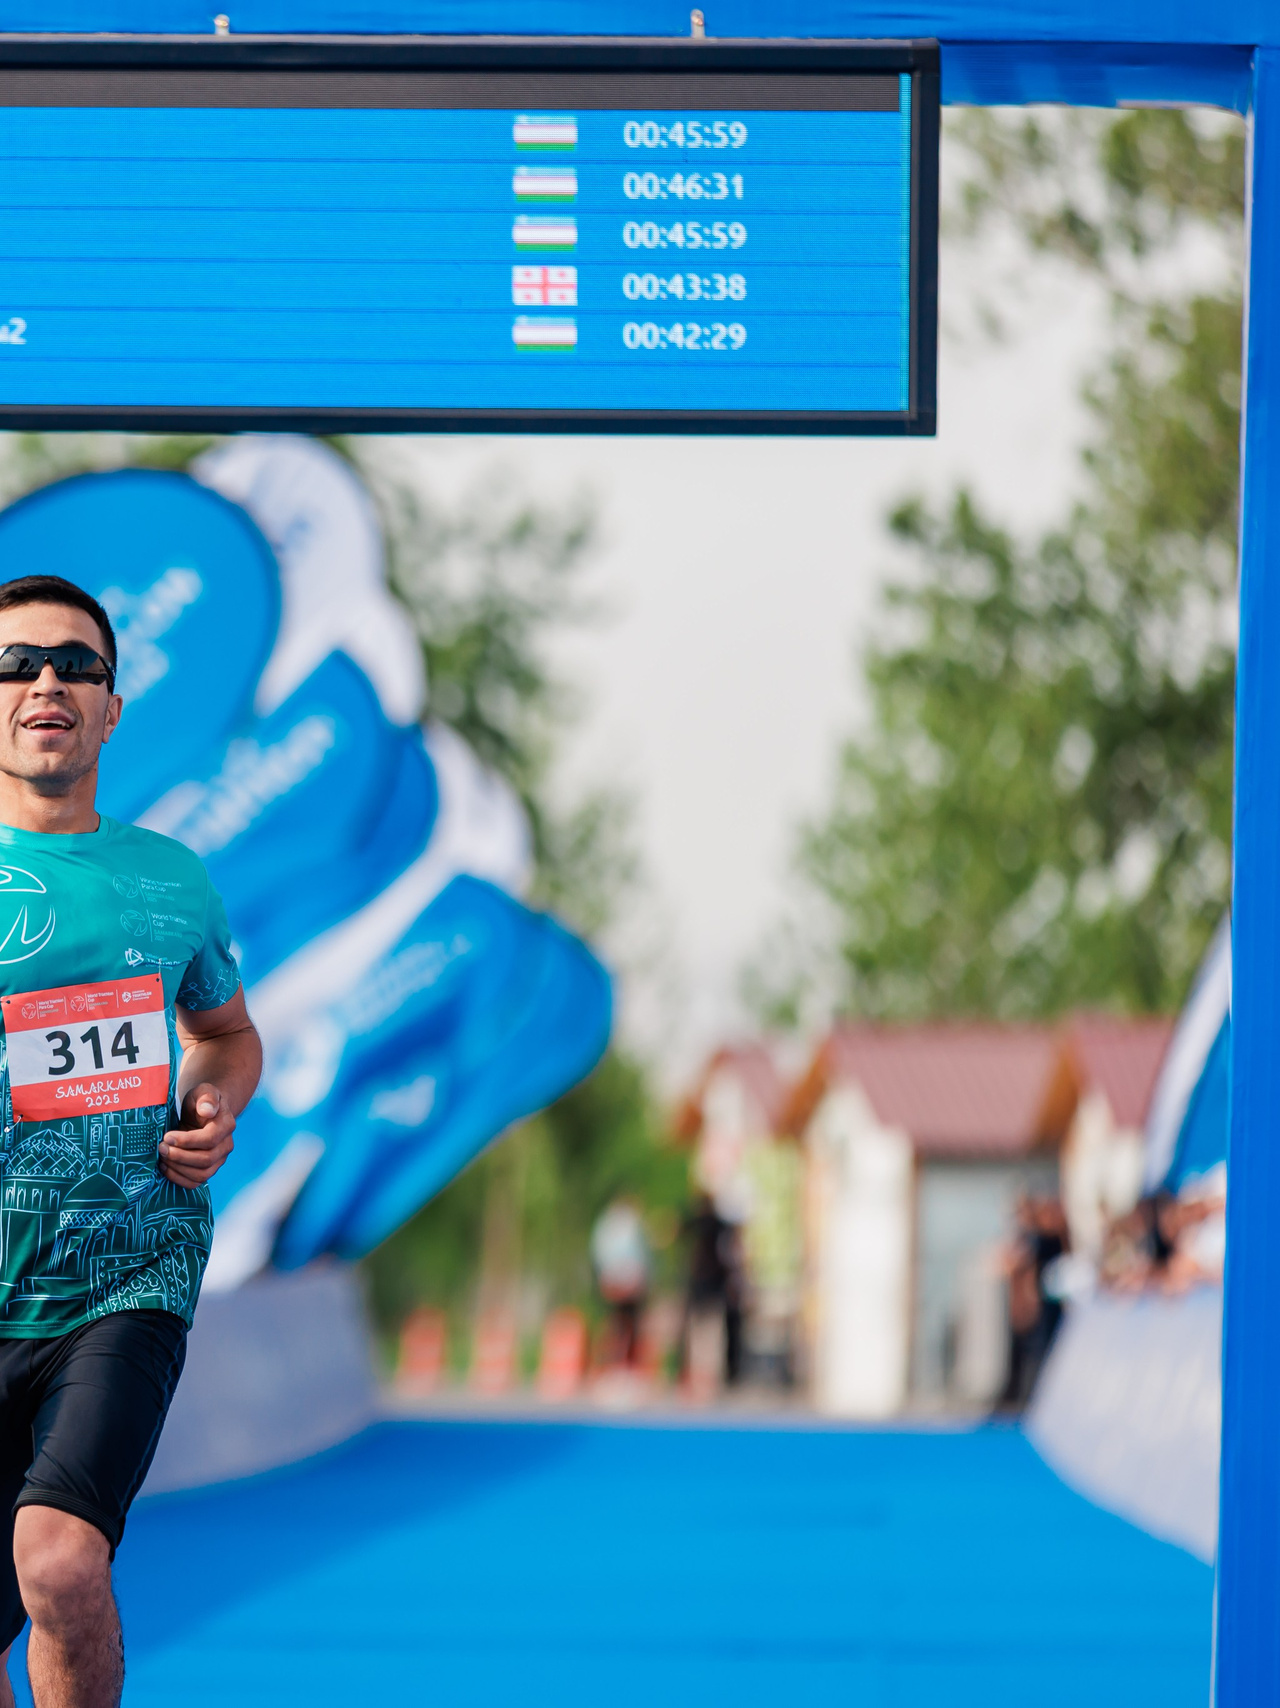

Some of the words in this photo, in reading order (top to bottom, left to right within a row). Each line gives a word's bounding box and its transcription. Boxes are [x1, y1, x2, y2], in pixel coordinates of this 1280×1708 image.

[623, 120, 748, 149] 00:45:59
[623, 172, 744, 200] 00:46:31
[622, 221, 748, 250] 00:45:59
[622, 273, 747, 301] 00:43:38
[622, 322, 747, 350] 00:42:29
[153, 920, 165, 928] Cup
[45, 1021, 140, 1076] 314
[55, 1075, 142, 1099] SAMARKAND
[85, 1093, 120, 1108] 2025
